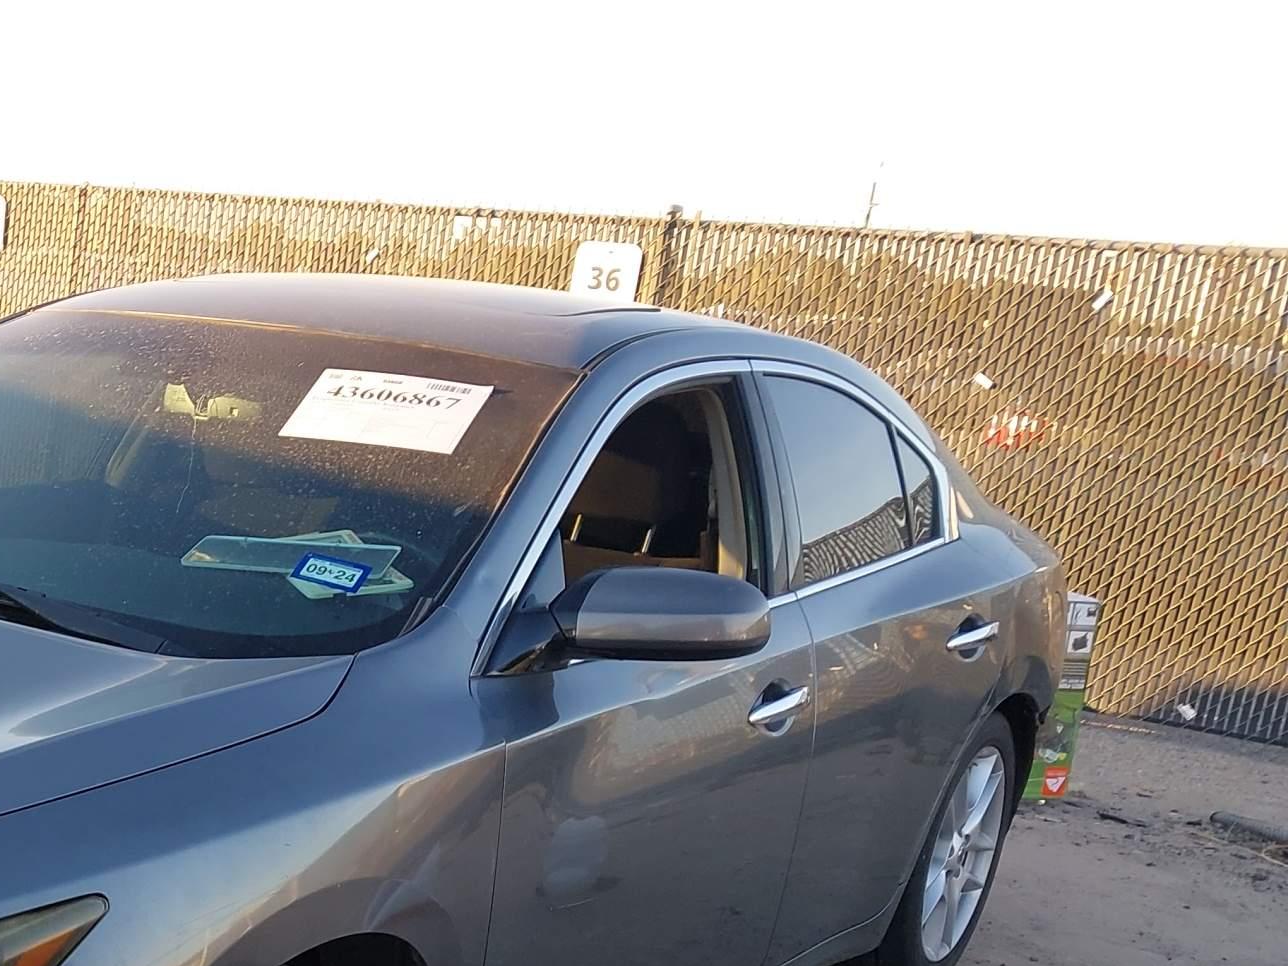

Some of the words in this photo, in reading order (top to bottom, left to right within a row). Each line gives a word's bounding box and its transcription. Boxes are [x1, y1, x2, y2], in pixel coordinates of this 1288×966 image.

[587, 266, 621, 292] 36
[327, 384, 463, 410] 43606867
[306, 563, 328, 576] 09
[333, 569, 357, 583] 24
